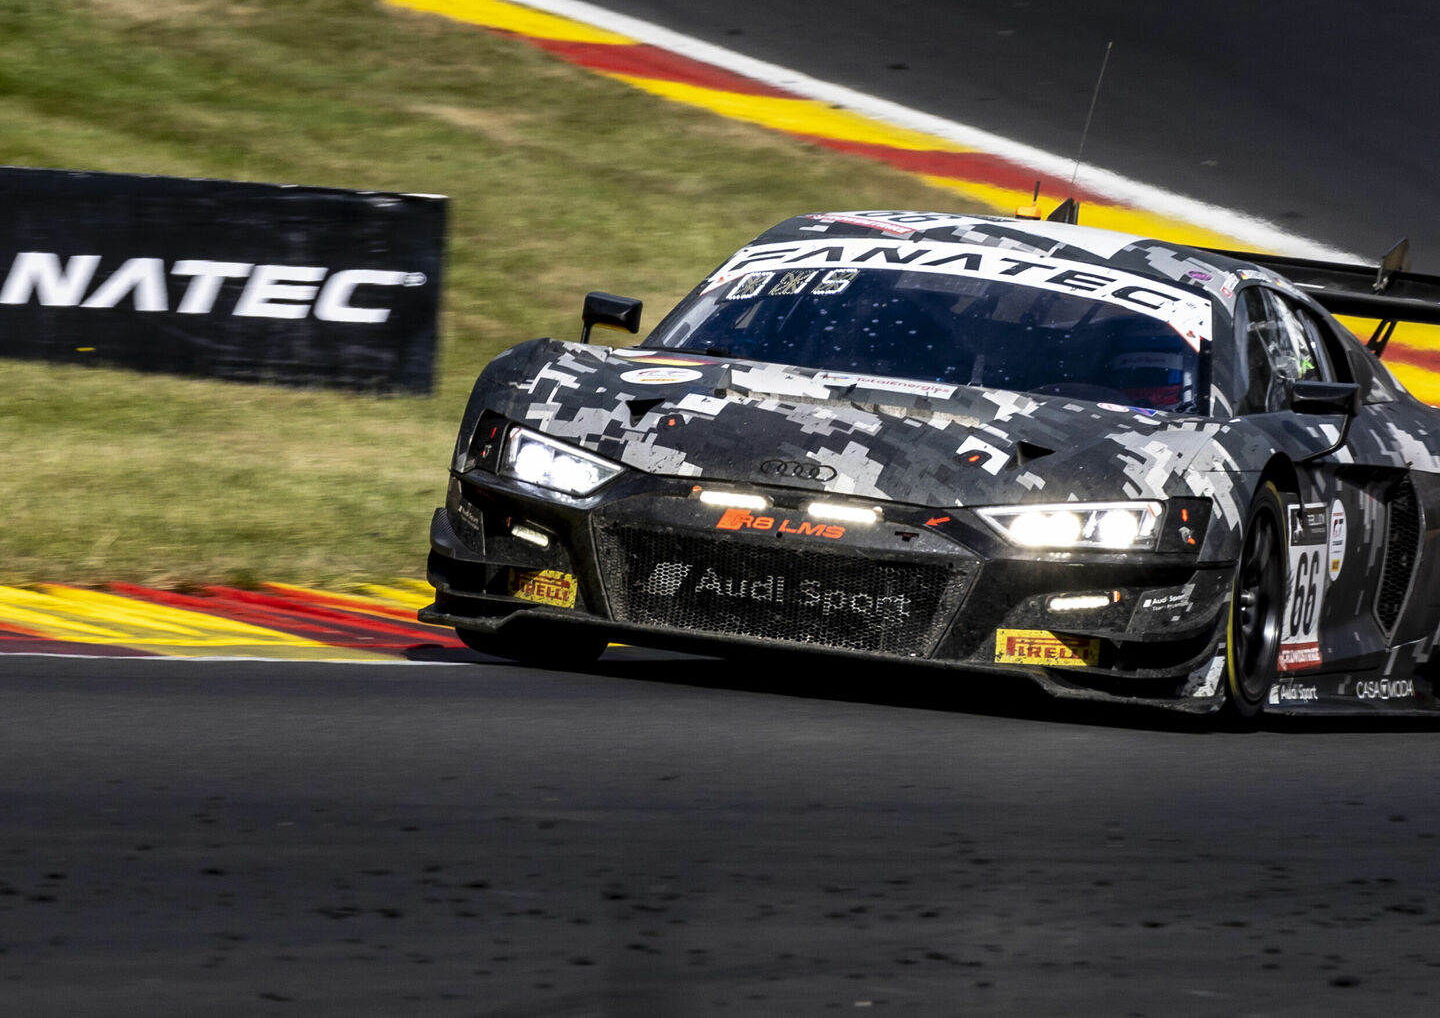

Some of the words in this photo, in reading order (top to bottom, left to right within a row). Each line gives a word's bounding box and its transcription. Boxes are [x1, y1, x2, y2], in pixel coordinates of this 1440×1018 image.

[0, 251, 405, 324] NATEC
[728, 245, 1182, 311] FANATEC
[857, 377, 951, 393] TotalEnergies
[778, 519, 846, 539] LMS
[695, 566, 784, 606] Audi
[800, 578, 912, 619] Sport
[1290, 551, 1320, 637] 66
[1006, 636, 1092, 660] PIRELLI
[1281, 685, 1299, 700] Audi
[1299, 684, 1319, 702] Sport
